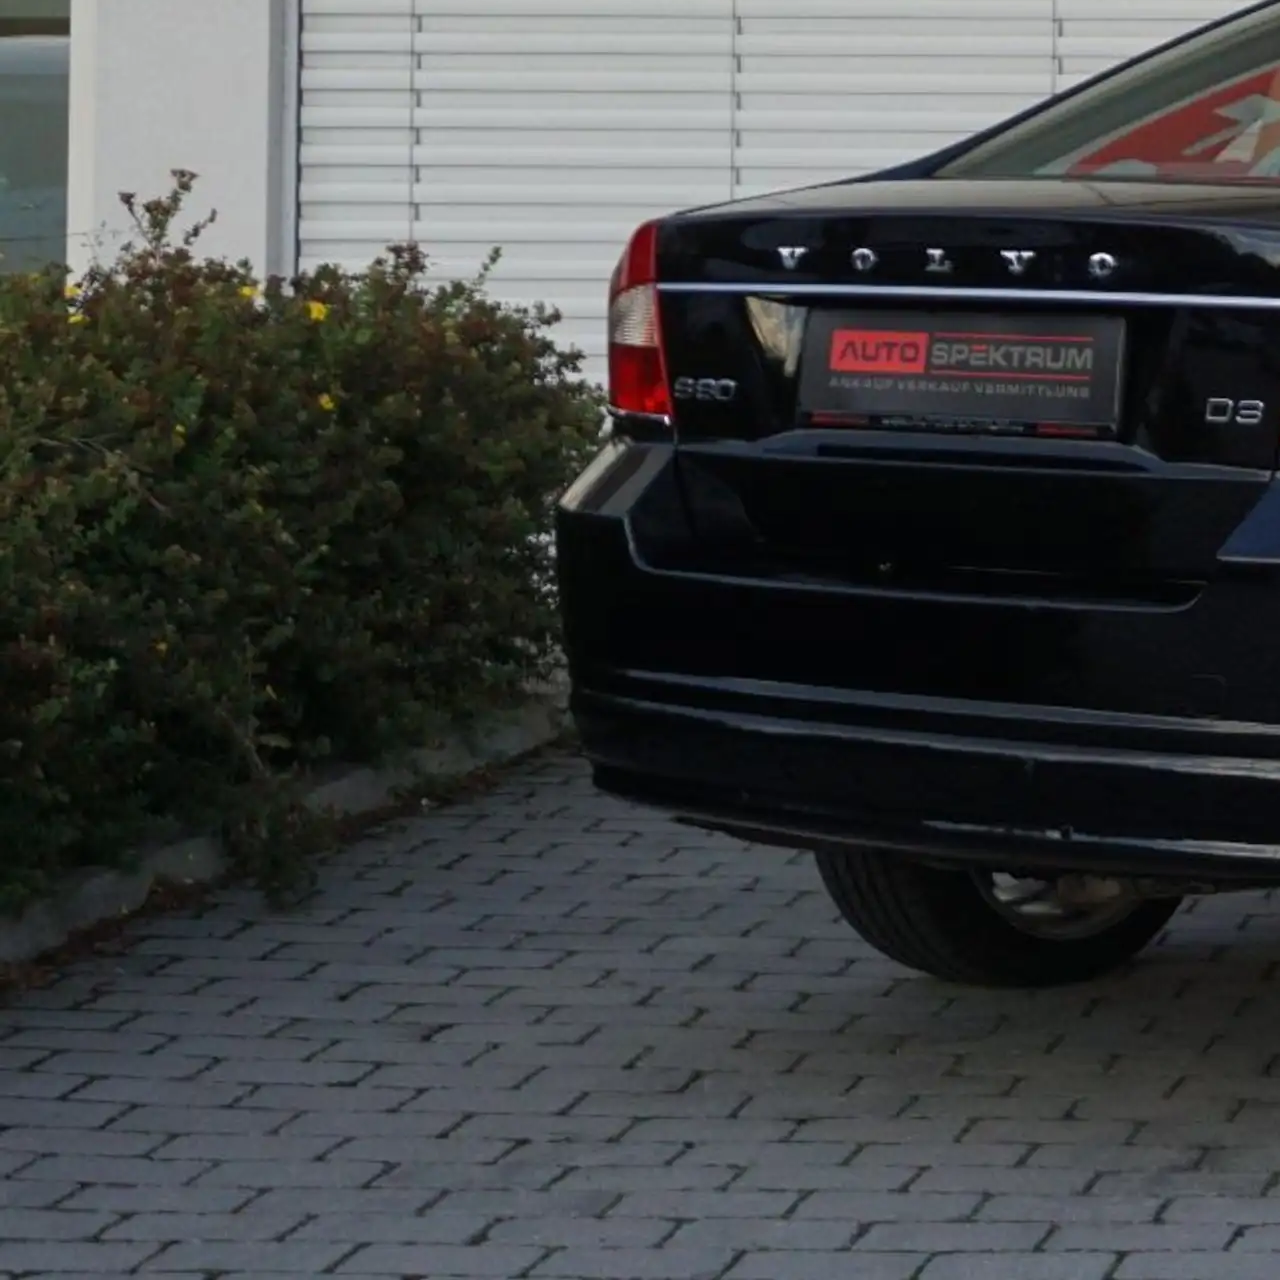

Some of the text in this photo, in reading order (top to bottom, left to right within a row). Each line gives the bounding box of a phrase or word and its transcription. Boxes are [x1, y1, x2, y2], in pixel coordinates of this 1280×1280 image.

[777, 246, 1118, 277] VOLVO
[839, 339, 1093, 370] AUTO SPEKTRUM
[897, 378, 970, 393] VERKAUF
[1205, 397, 1264, 424] D3
